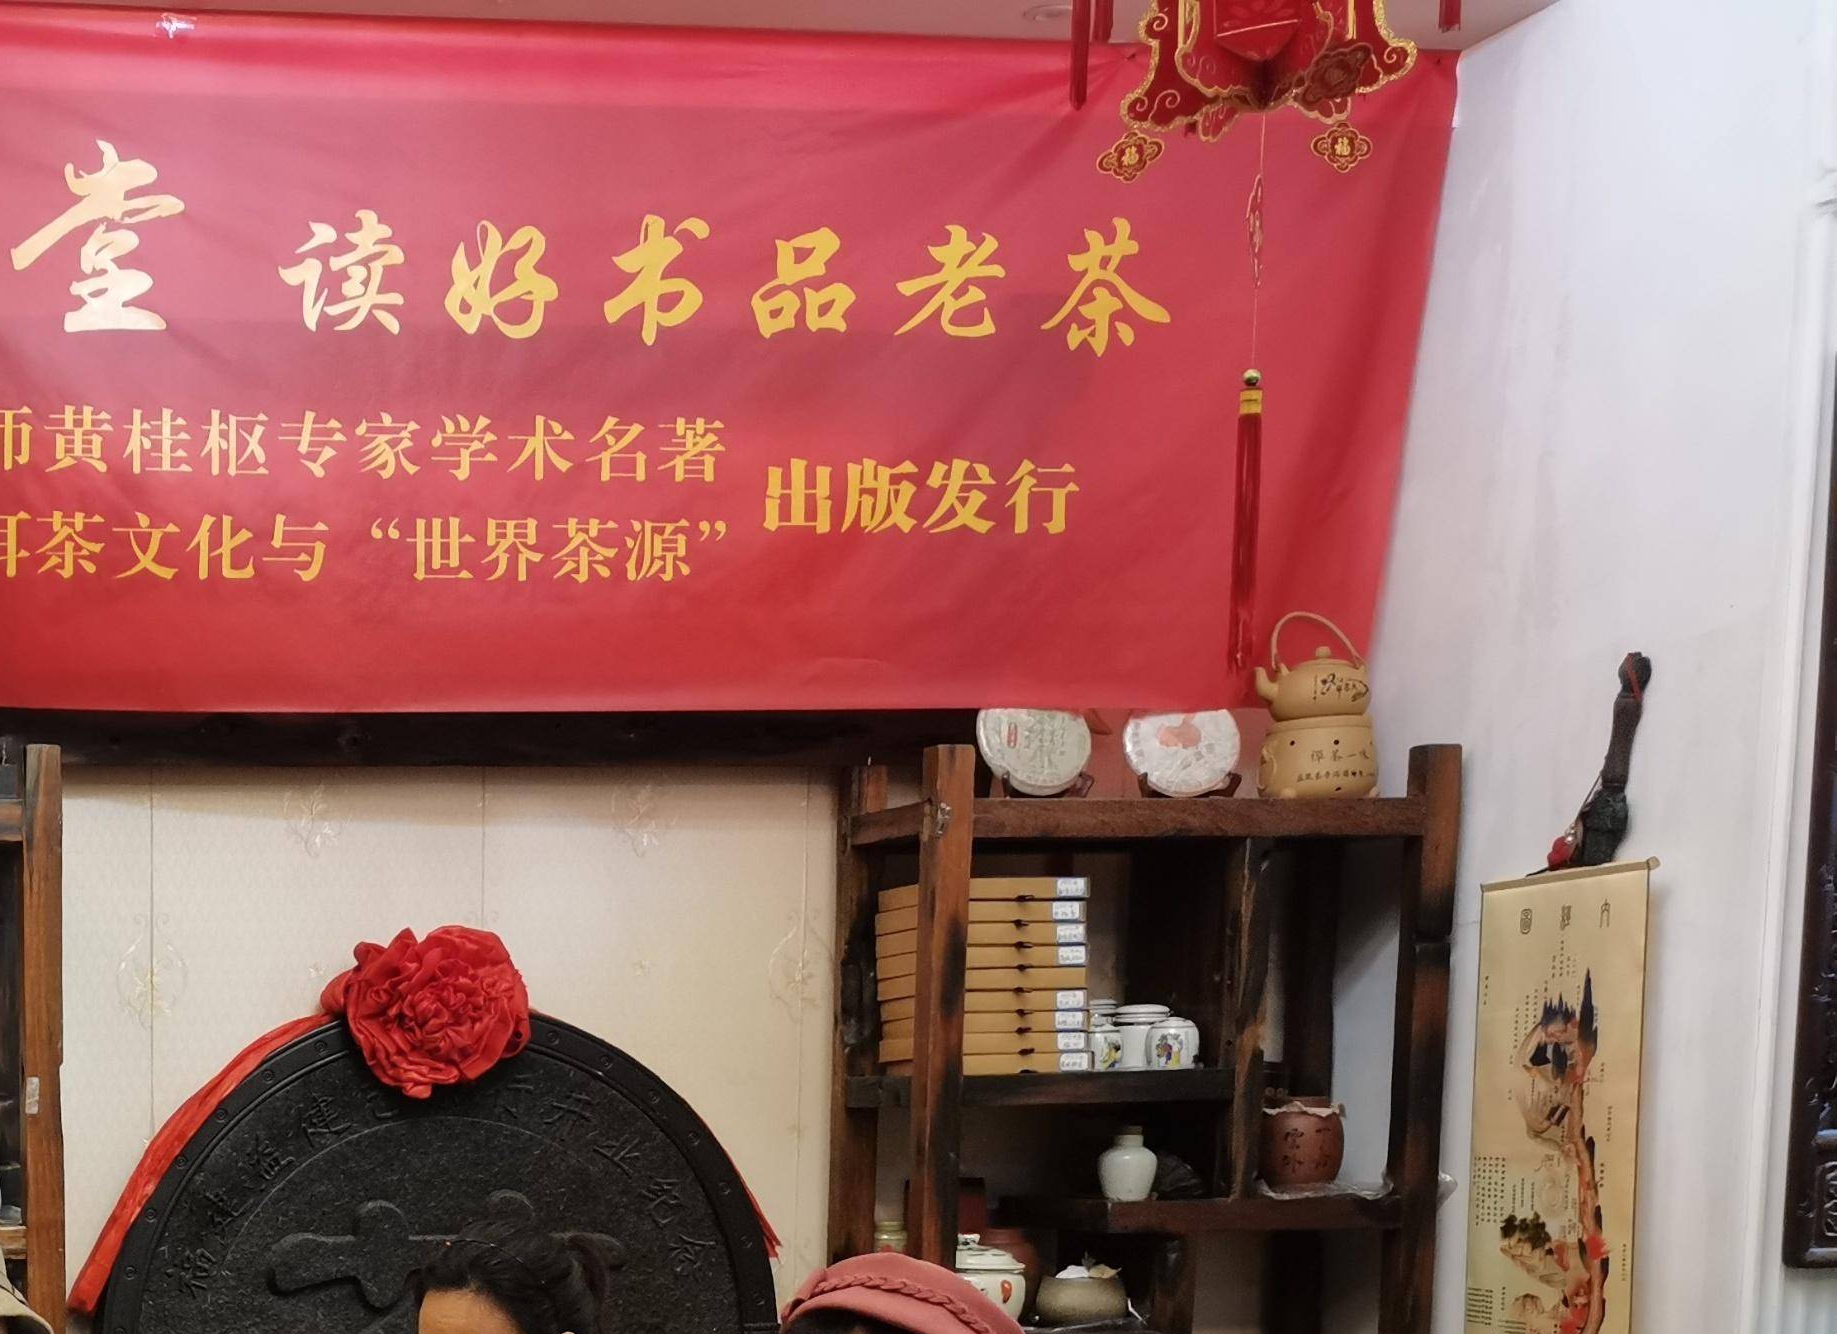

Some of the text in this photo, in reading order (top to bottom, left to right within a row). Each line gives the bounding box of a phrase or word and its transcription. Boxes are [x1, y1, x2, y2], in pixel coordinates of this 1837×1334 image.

[277, 208, 1171, 357] 读好书品老茶
[763, 456, 1080, 535] 出版发行
